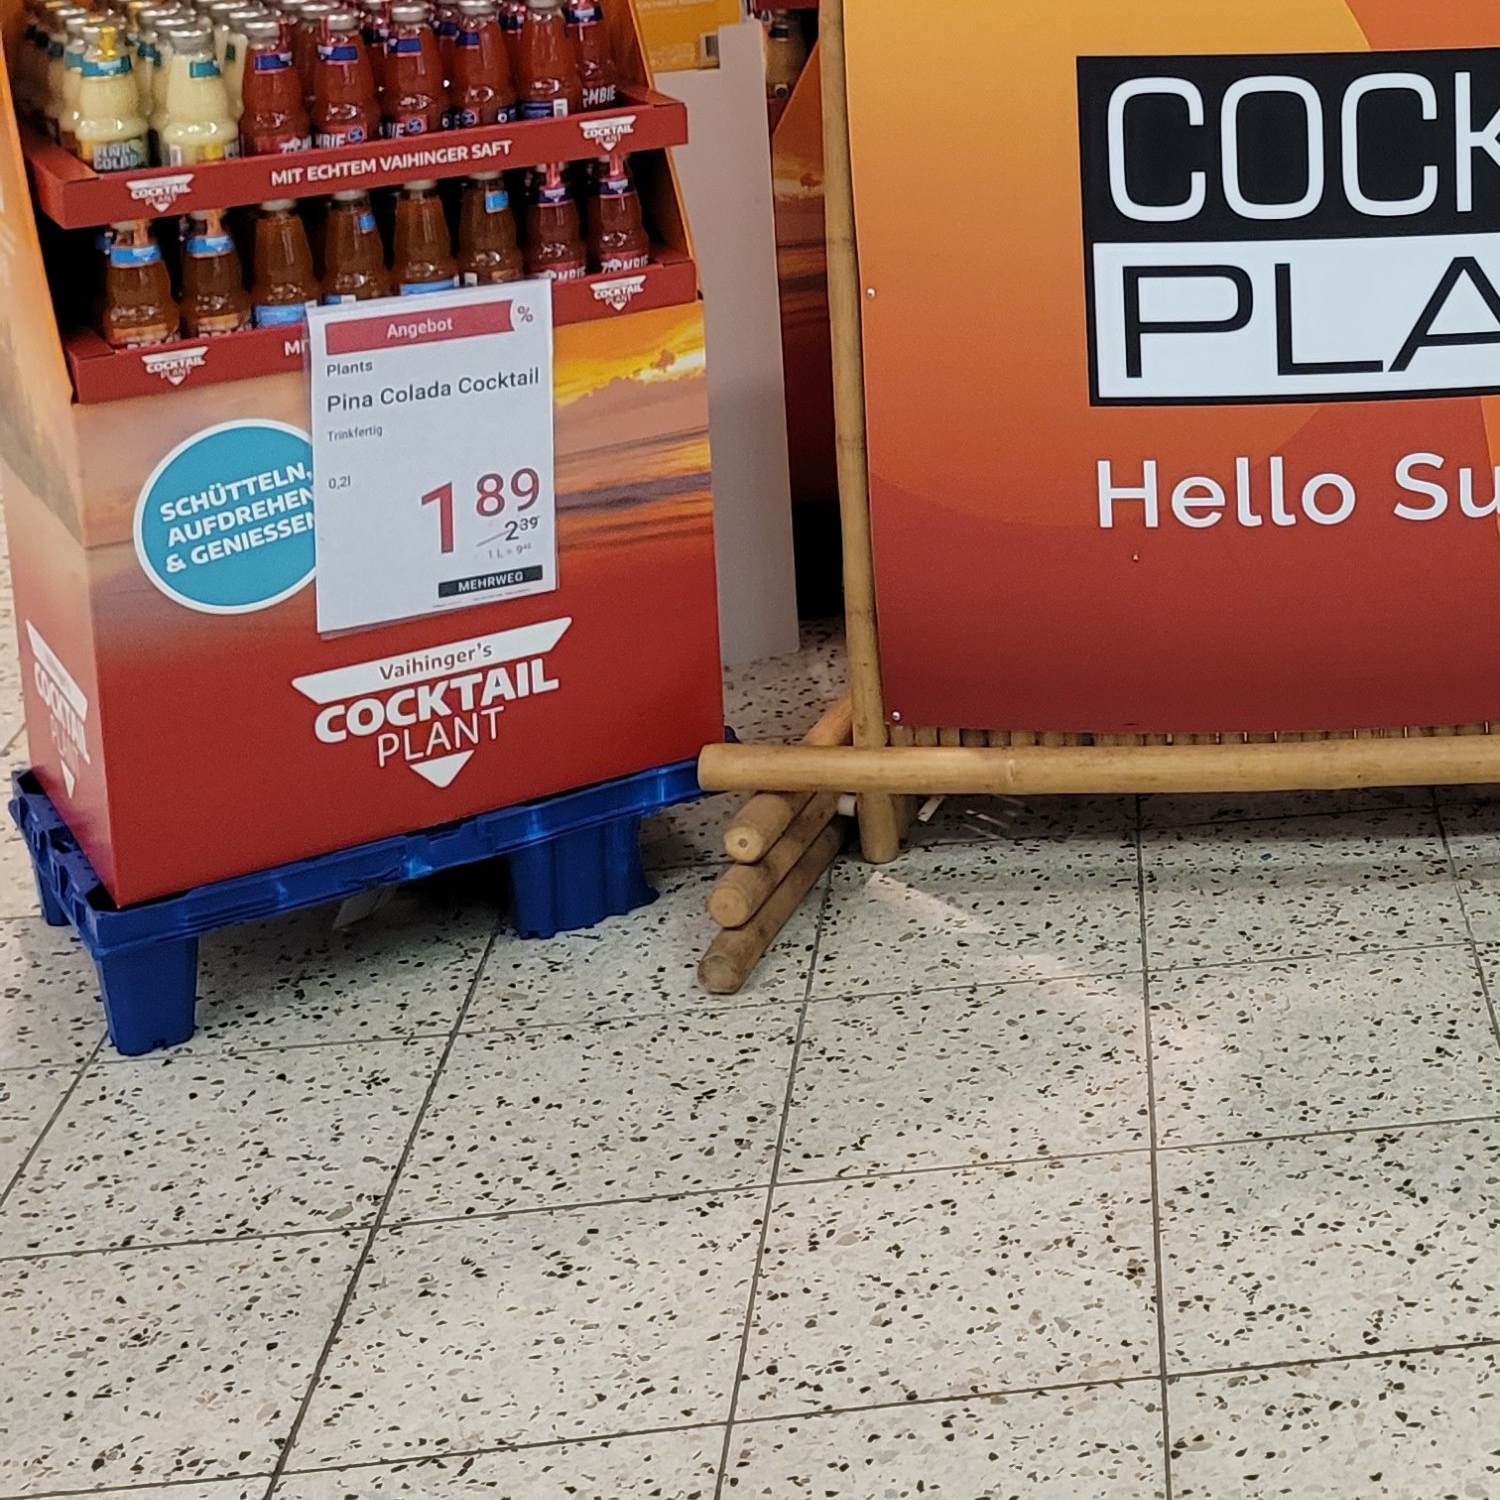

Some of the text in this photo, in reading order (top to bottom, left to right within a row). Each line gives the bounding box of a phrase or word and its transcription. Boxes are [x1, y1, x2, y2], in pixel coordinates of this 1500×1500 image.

[583, 123, 634, 140] COCKTAIL
[271, 139, 513, 187] MIT ECHTEM VAIHINGER SAFT
[131, 182, 192, 200] COCKTAIL
[594, 282, 644, 300] COCKTAIL
[386, 305, 534, 339] Angebot %
[146, 356, 206, 374] COCKTAIL
[326, 360, 373, 377] Plants
[327, 366, 540, 413] Pina Colada Cocktail
[327, 425, 383, 442] Trinkfertig
[159, 461, 312, 522] SCHÜTTELN,
[328, 475, 351, 491] 0,2l
[1096, 454, 1357, 529] Hello
[167, 486, 315, 548] AUFDREHEN
[165, 552, 187, 574] &
[457, 570, 525, 593] MEHRWEG
[378, 642, 493, 682] Vaihinger's
[313, 658, 560, 744] COCKTAIL
[376, 706, 506, 768] PLANT
